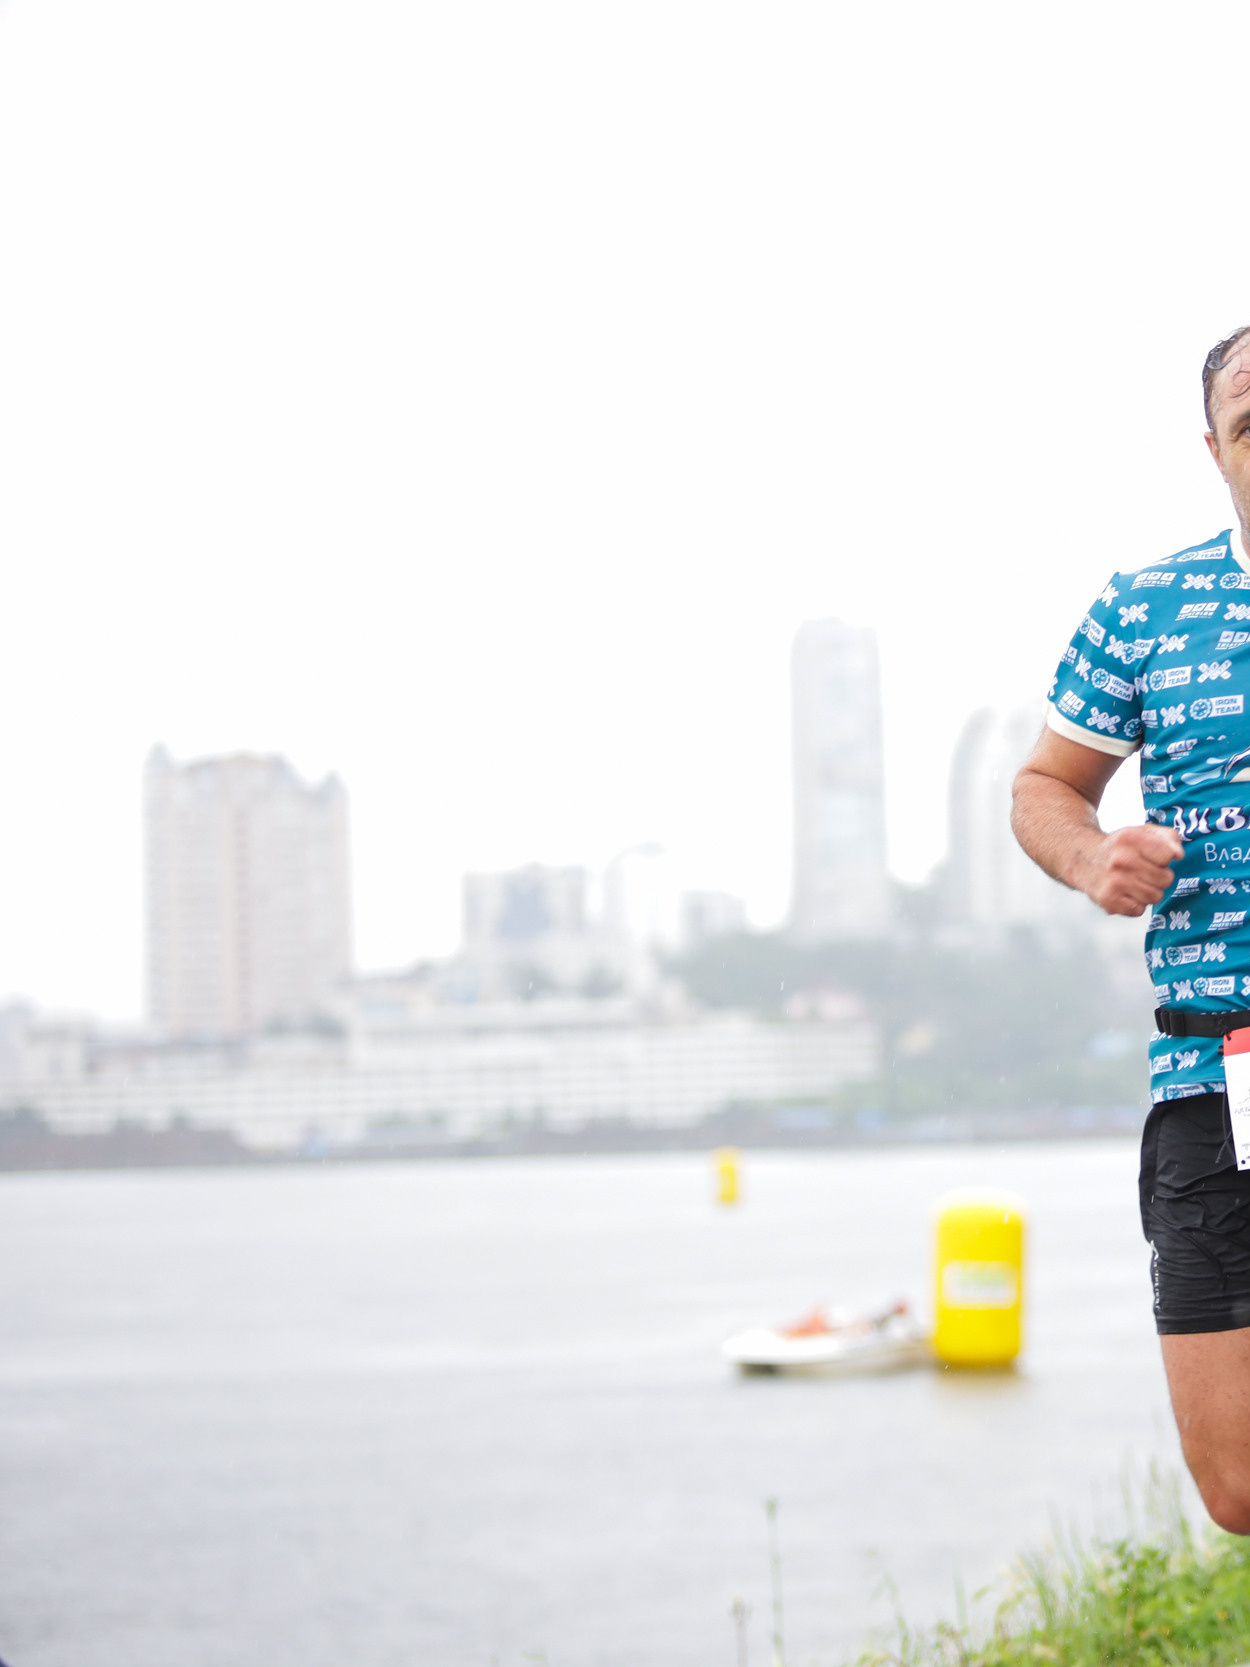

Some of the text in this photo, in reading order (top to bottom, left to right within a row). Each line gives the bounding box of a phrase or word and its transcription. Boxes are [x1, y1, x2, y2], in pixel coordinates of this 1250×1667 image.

[1167, 668, 1186, 678] IRON
[1167, 675, 1189, 685] TEAM
[1112, 679, 1131, 692] IRON
[1109, 685, 1132, 700] TEAM
[1215, 698, 1238, 706] IRON
[1215, 705, 1241, 714] TEAM
[1211, 986, 1233, 994] TEAM
